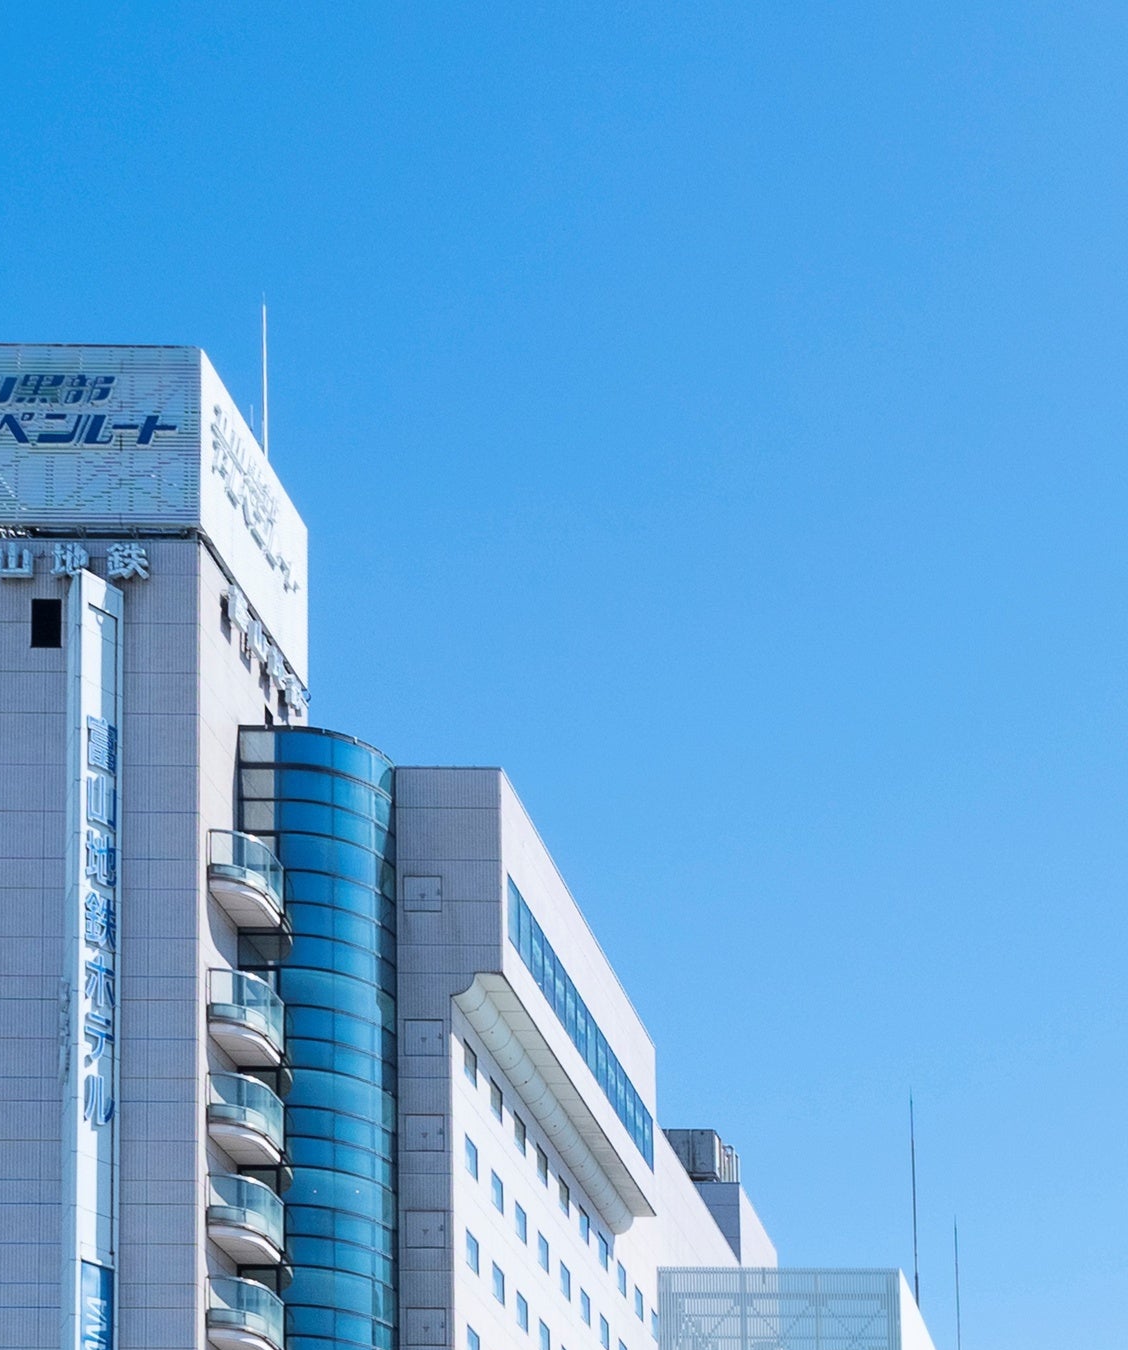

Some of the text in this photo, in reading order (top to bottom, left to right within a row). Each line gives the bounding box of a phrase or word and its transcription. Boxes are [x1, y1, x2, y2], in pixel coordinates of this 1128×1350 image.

[84, 714, 118, 1127] 富山地鉄ホテル
